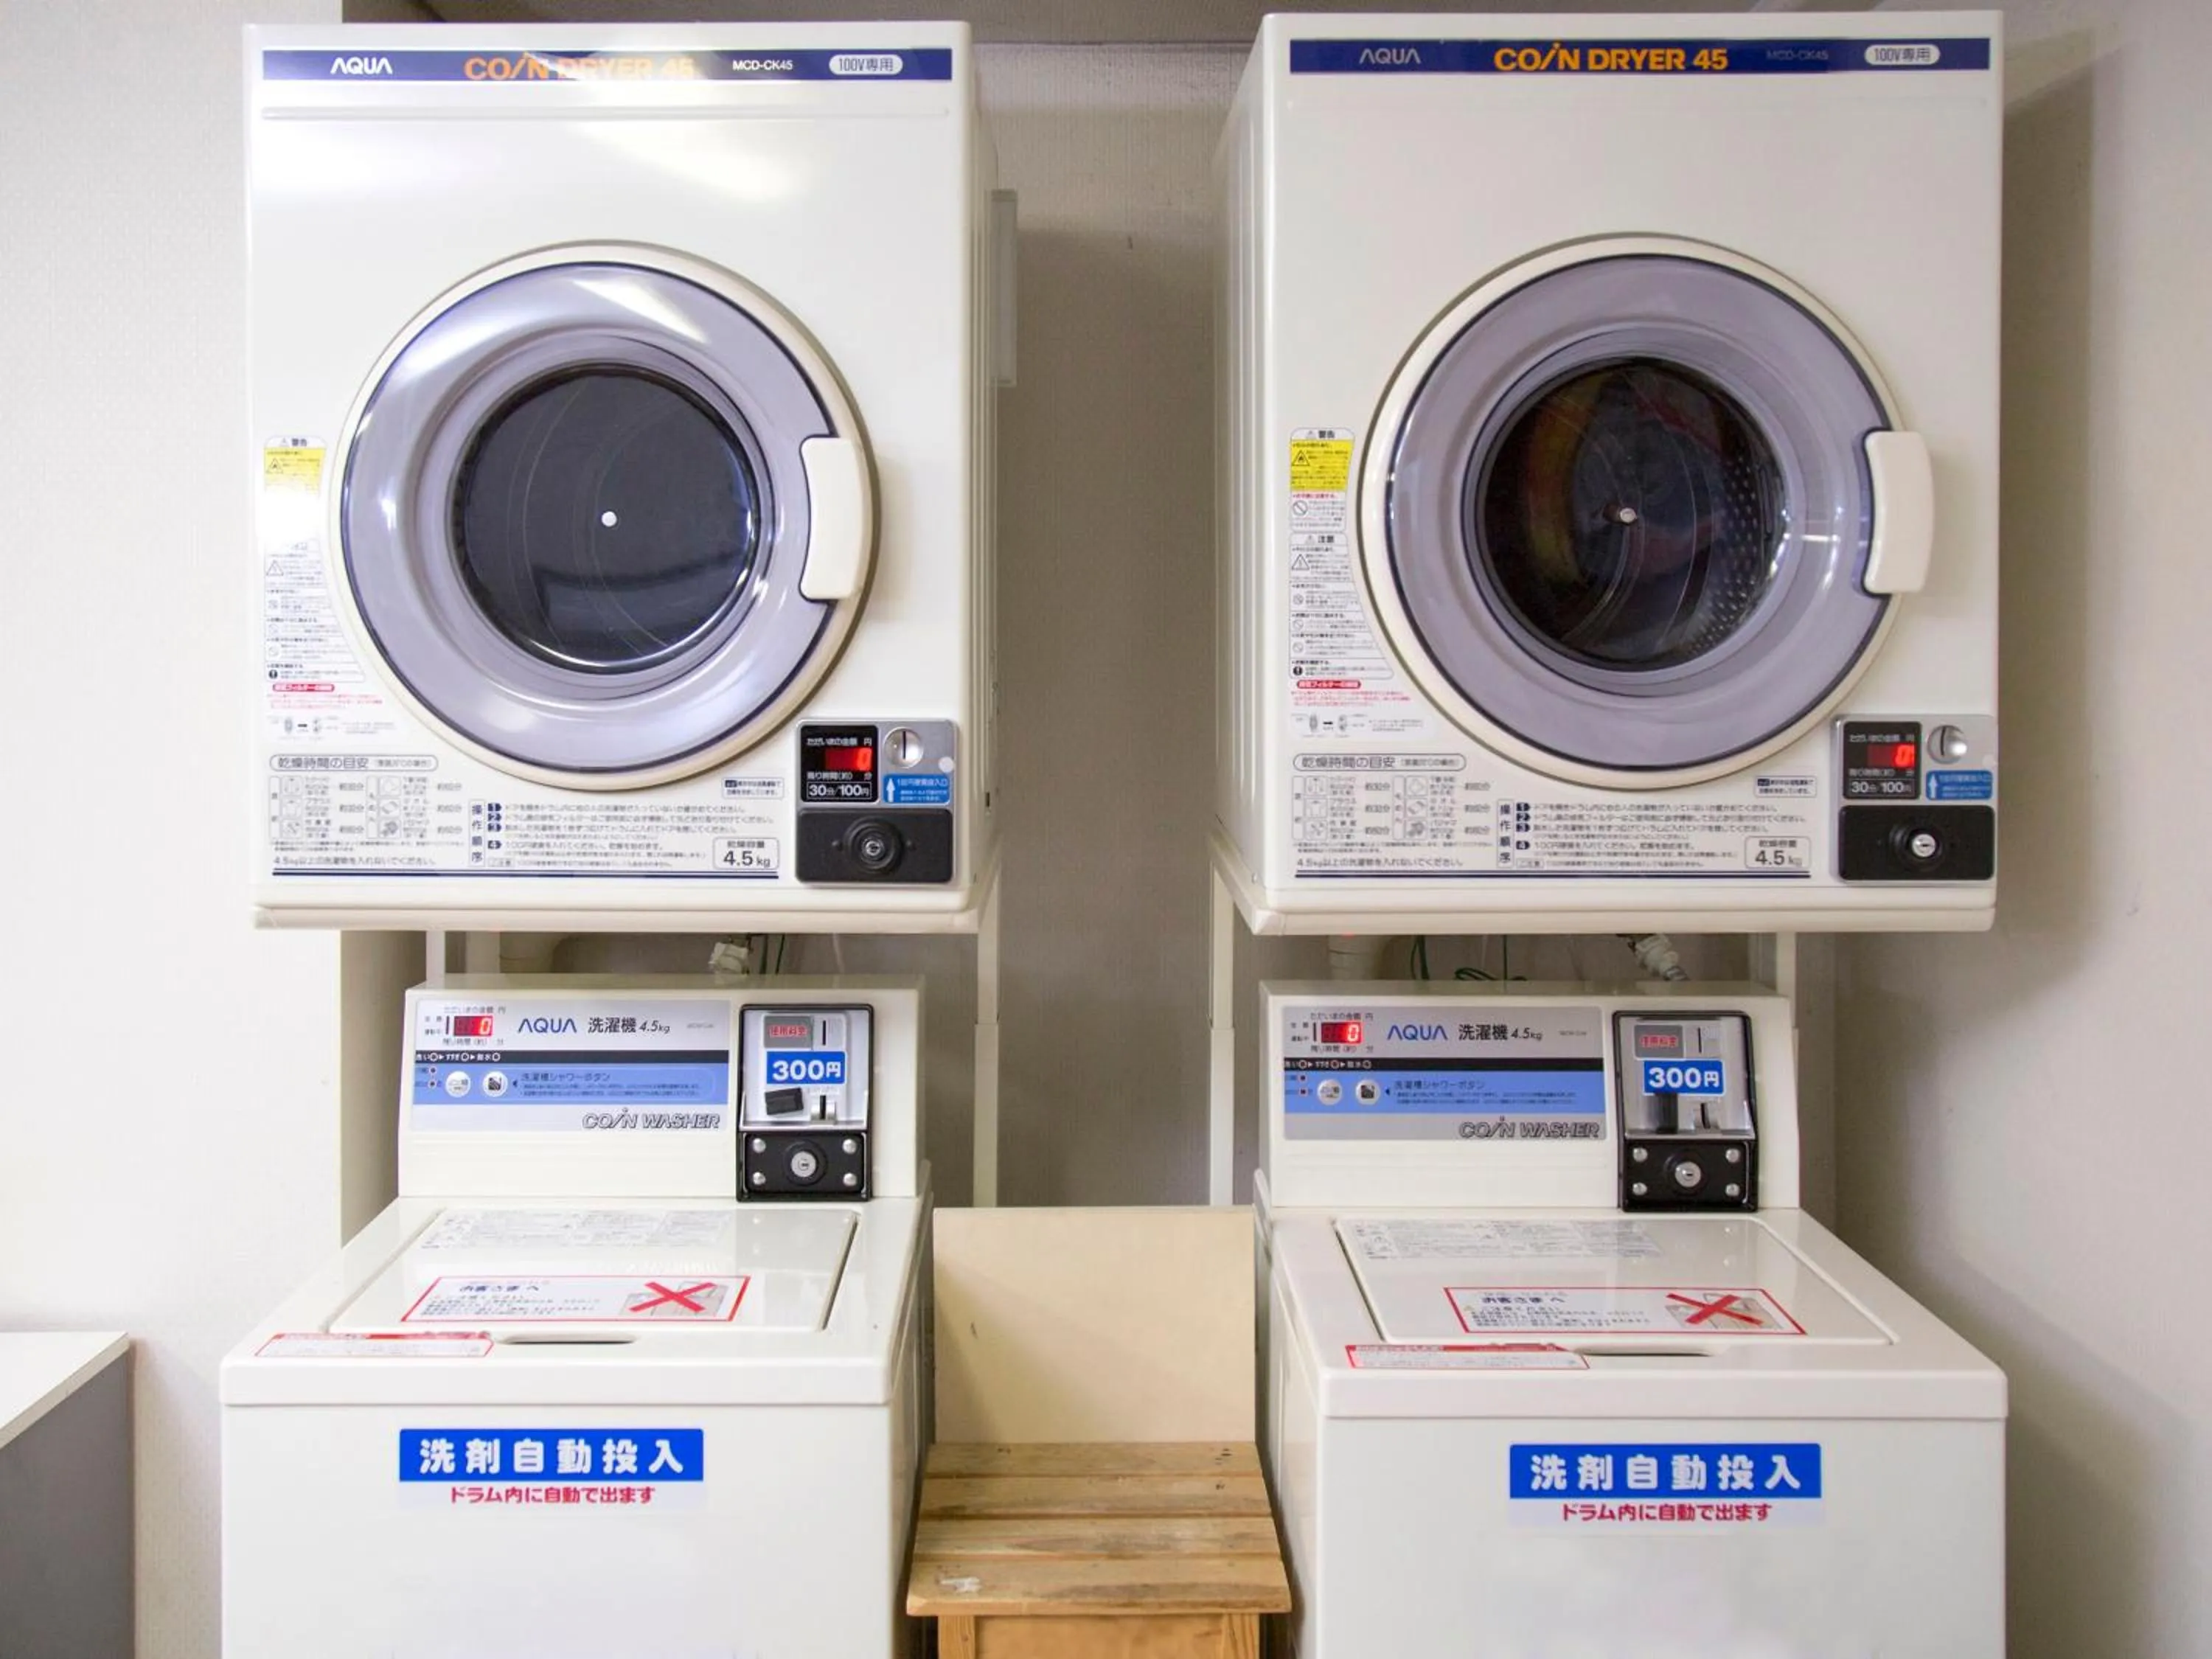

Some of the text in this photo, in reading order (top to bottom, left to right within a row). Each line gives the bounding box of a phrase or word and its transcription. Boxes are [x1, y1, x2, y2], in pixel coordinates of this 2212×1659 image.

[1360, 48, 1422, 65] AQUA
[1587, 49, 1686, 71] DRYER
[1692, 49, 1728, 71] 45
[330, 57, 393, 75] AQUA
[732, 60, 793, 71] MCD-CK45
[723, 849, 754, 866] 4.5
[757, 856, 771, 868] kg
[1755, 849, 1785, 866] 4.5
[479, 1018, 492, 1035] 0
[518, 1018, 577, 1034] AQUA
[588, 1017, 636, 1033] 洗濯機
[1347, 1024, 1360, 1042] 0
[1387, 1024, 1448, 1040] AQUA
[1458, 1023, 1508, 1040] 洗濯機
[773, 1060, 841, 1081] 300円
[1649, 1067, 1719, 1088] 300円
[641, 1113, 720, 1130] WASHER
[1520, 1121, 1599, 1138] WASHER
[419, 1438, 684, 1475] 洗剤自動投入
[1530, 1454, 1801, 1491] 洗剤自動投入
[451, 1486, 655, 1504] ドラム内に自動で出ます
[1561, 1503, 1773, 1523] ドラム内に自動で出ます
